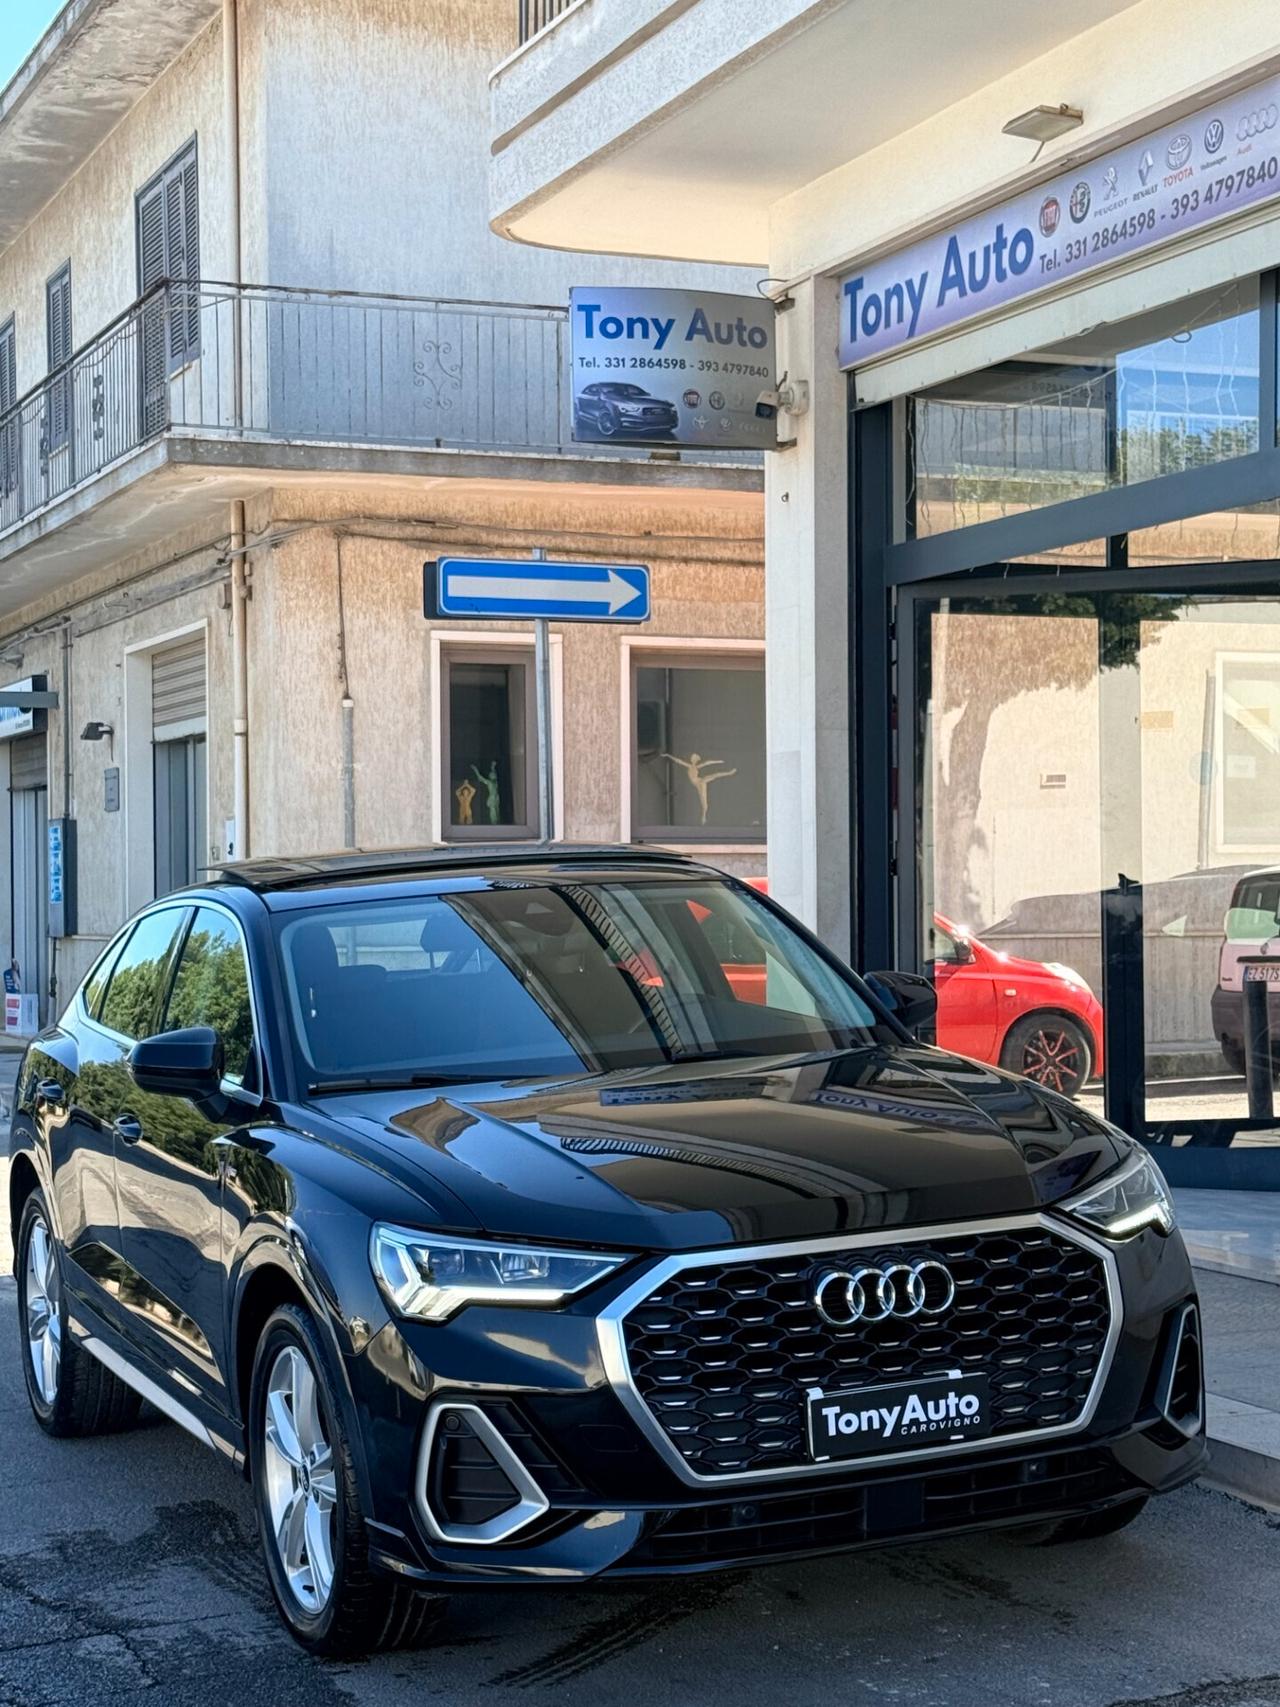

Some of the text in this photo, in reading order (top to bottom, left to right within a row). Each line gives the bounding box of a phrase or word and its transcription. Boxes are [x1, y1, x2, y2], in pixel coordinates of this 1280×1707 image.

[1163, 167, 1194, 188] TOYOTA
[1039, 249, 1061, 274] Tel.
[1065, 236, 1088, 264] 331
[1091, 208, 1156, 253] 2864598
[1171, 190, 1199, 219] 393
[1203, 156, 1278, 205] 4797840
[844, 223, 1034, 344] Tony Auto
[577, 304, 767, 350] Tony Auto
[579, 357, 600, 369] Tel.
[604, 357, 626, 368] 331
[630, 357, 686, 370] 2864598
[698, 360, 719, 372] 393
[722, 362, 769, 378] 4797840
[901, 1415, 981, 1435] CAROVIGNO
